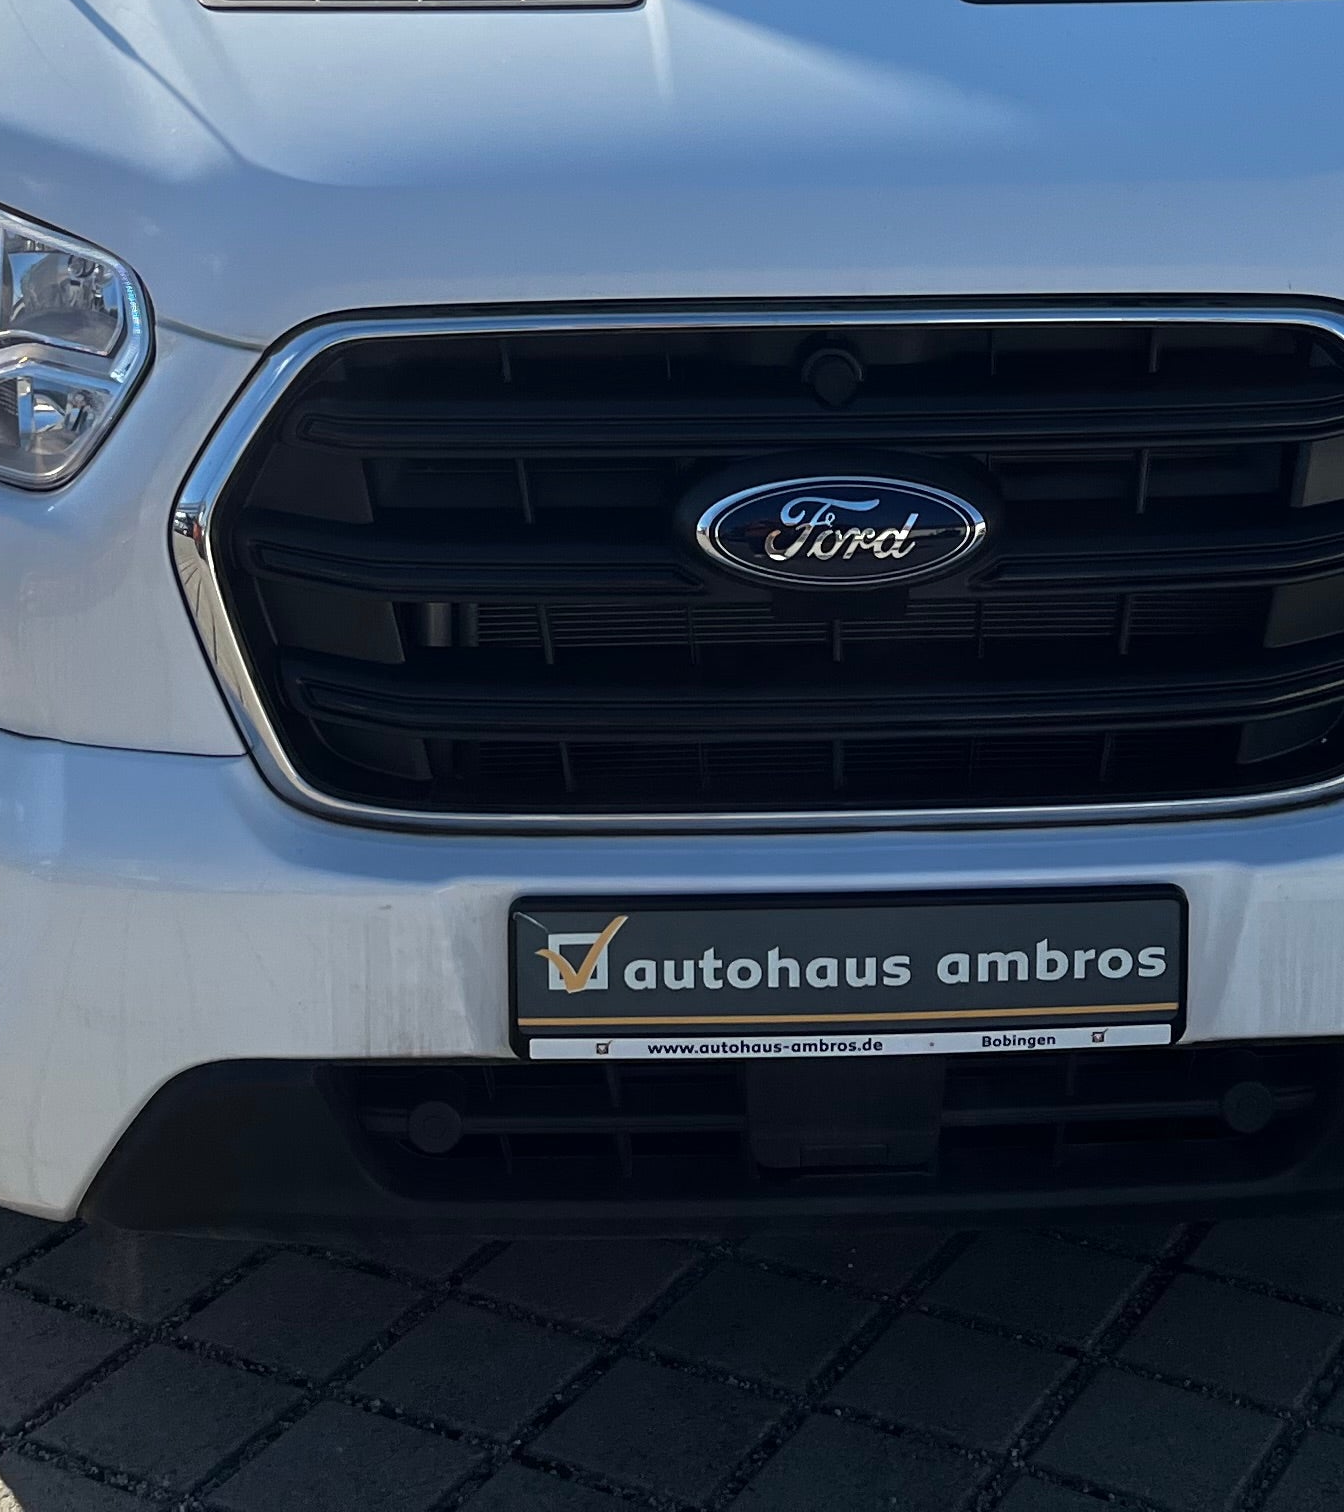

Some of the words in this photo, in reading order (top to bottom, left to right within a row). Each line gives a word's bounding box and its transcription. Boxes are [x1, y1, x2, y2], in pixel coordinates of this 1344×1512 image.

[764, 496, 919, 561] Ford
[623, 946, 912, 990] autohaus
[936, 938, 1167, 984] ambros
[647, 1037, 884, 1056] www.autohaus-ambros.de
[981, 1032, 1057, 1050] Bobingen
